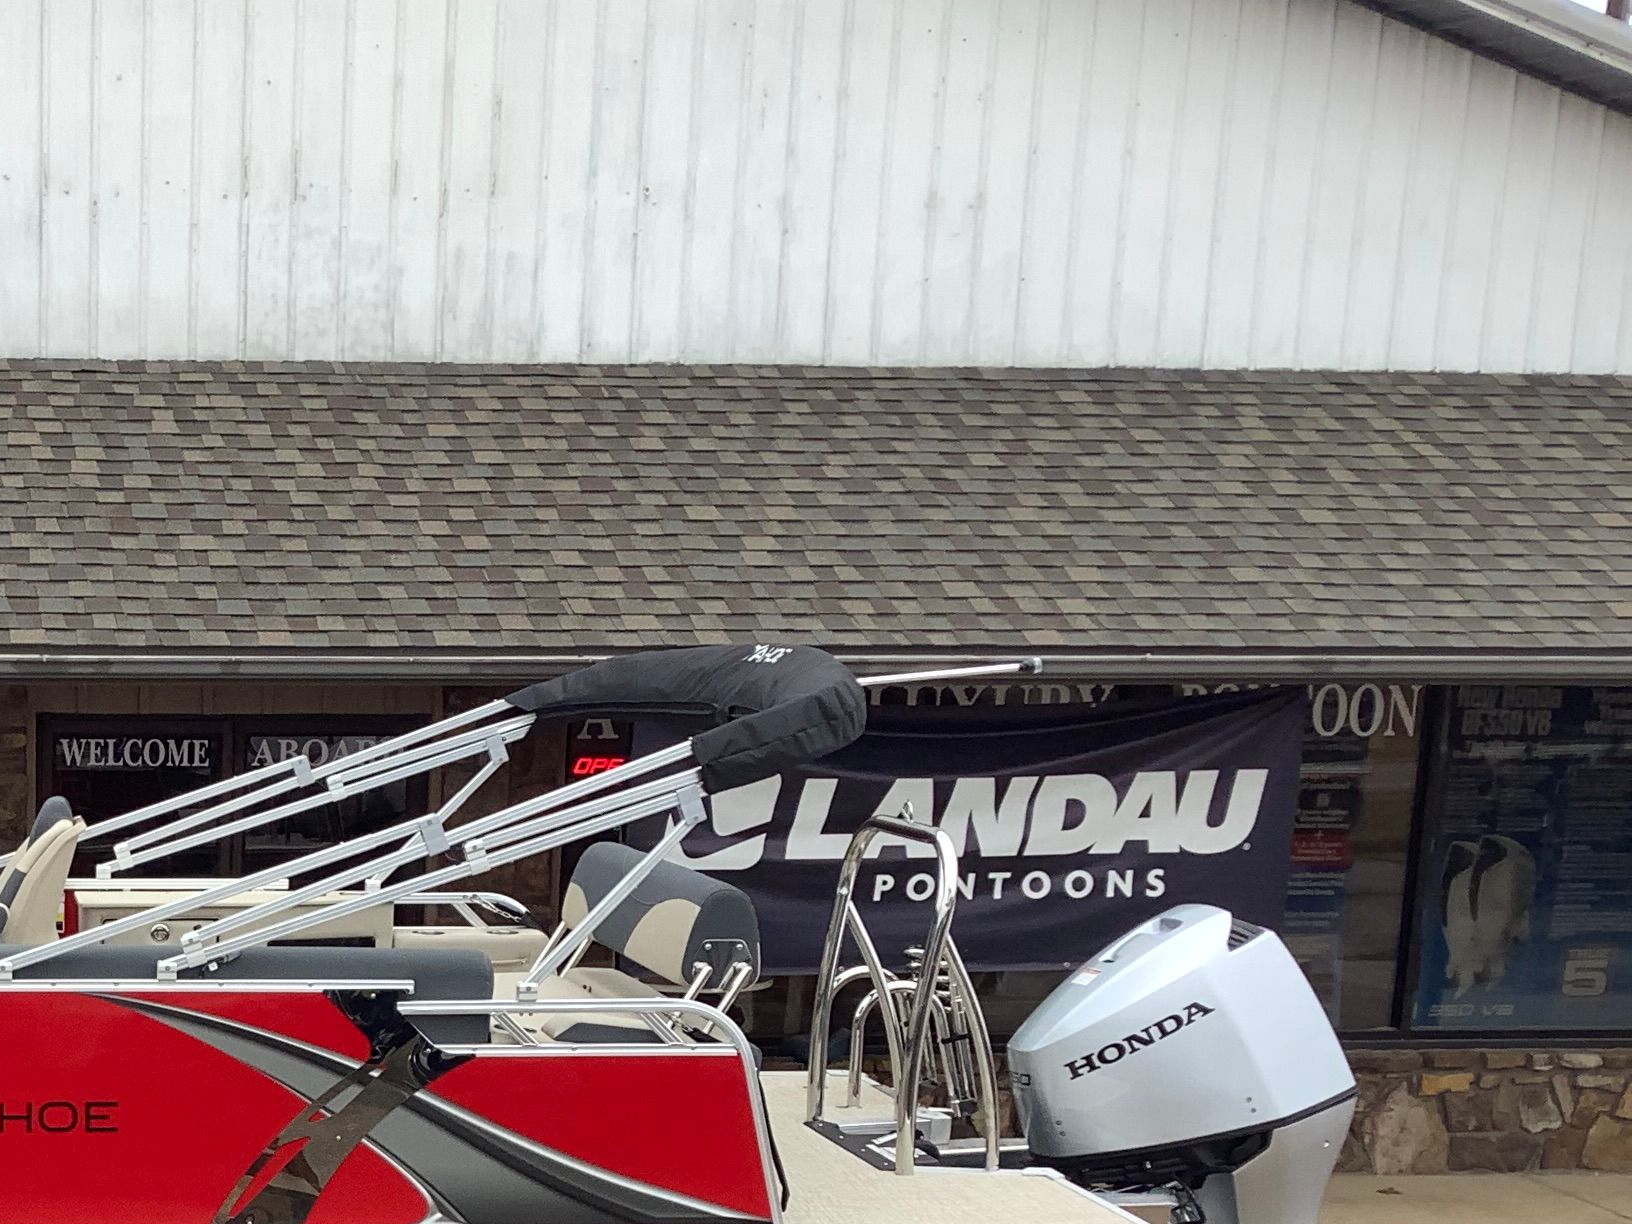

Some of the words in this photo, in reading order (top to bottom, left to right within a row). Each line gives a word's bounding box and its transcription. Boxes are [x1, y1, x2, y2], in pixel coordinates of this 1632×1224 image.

[59, 738, 210, 767] WELCOME
[250, 738, 404, 768] ABOA
[784, 769, 1269, 860] LANDAU
[872, 868, 1167, 901] PONTOONS
[1064, 1001, 1215, 1080] HONDA
